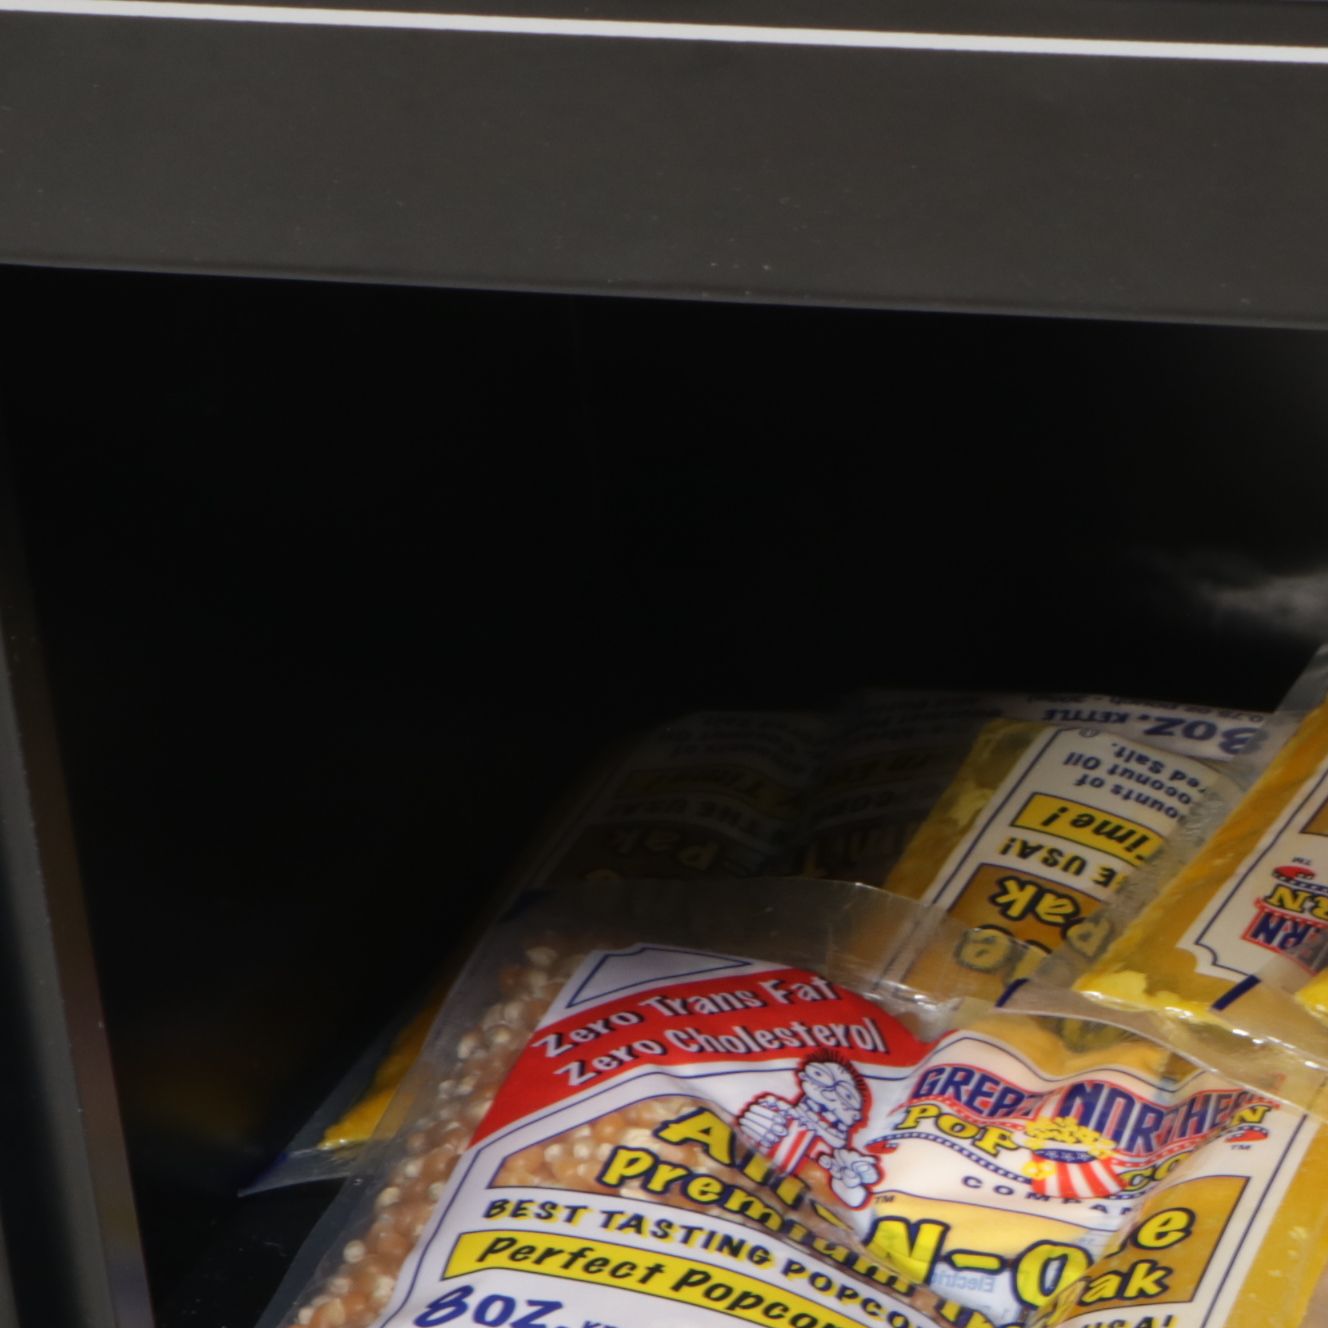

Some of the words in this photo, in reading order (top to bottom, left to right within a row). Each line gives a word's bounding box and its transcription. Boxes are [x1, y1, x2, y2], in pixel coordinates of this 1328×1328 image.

[1106, 764, 1192, 805] oconut
[1041, 807, 1152, 861] ime!
[999, 837, 1088, 891] USA!
[530, 1009, 644, 1059] Zero
[639, 986, 767, 1021] Trans
[759, 975, 844, 1006] Fat
[553, 1040, 668, 1087] Zero
[664, 1017, 891, 1055] Cholesterol
[482, 1198, 592, 1227] BEST
[598, 1209, 776, 1269] TASTING
[475, 1236, 666, 1286] Perfect
